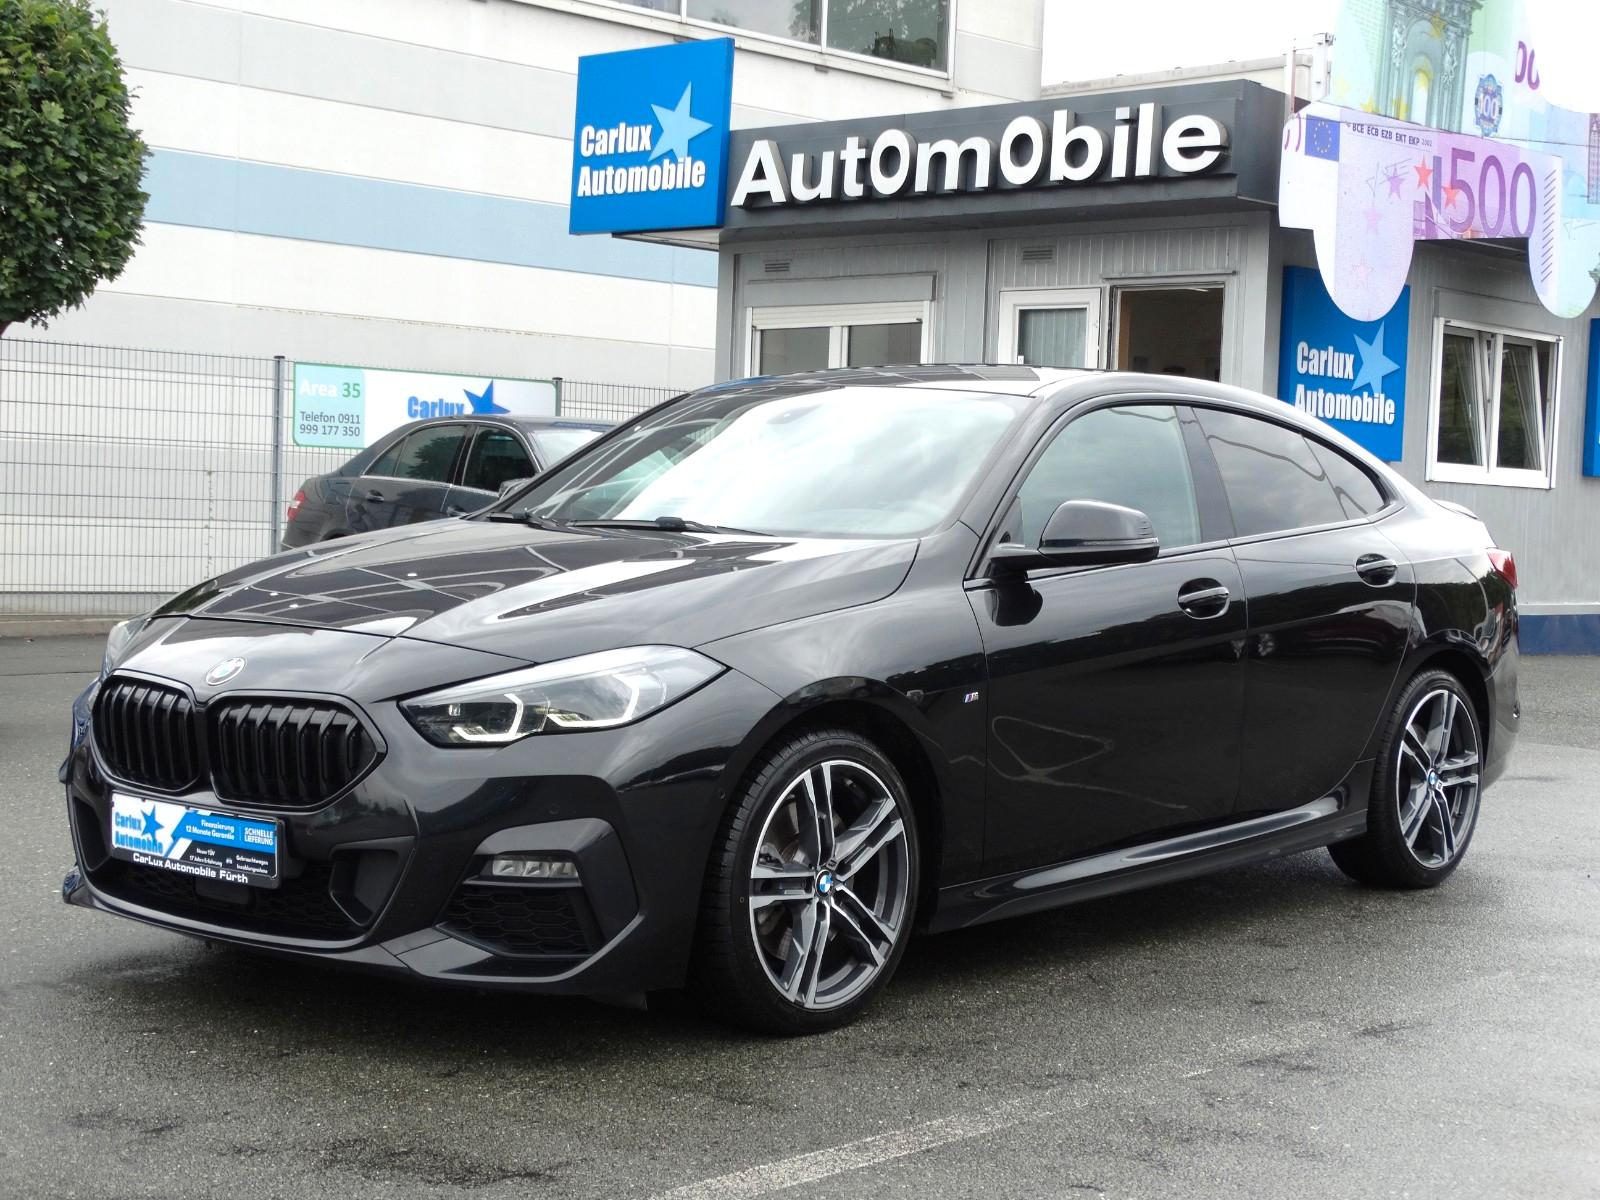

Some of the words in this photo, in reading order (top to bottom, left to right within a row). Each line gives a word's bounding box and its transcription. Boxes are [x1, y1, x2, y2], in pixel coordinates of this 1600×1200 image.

[581, 122, 652, 157] Carlux
[577, 156, 706, 198] Automobile
[1296, 341, 1355, 380] Carlux
[299, 379, 338, 399] Area
[342, 382, 361, 399] 35
[407, 395, 466, 420] Carlux
[1294, 384, 1396, 425] Automobile
[299, 411, 336, 425] Telefon
[338, 412, 361, 425] 0911
[299, 424, 319, 435] 999
[321, 425, 340, 436] 177
[341, 426, 361, 437] 350
[114, 811, 142, 831] Carlux
[114, 830, 163, 854] Automobile
[132, 852, 164, 868] CarLux
[164, 859, 217, 878] Automobile
[219, 870, 249, 885] Fürth
